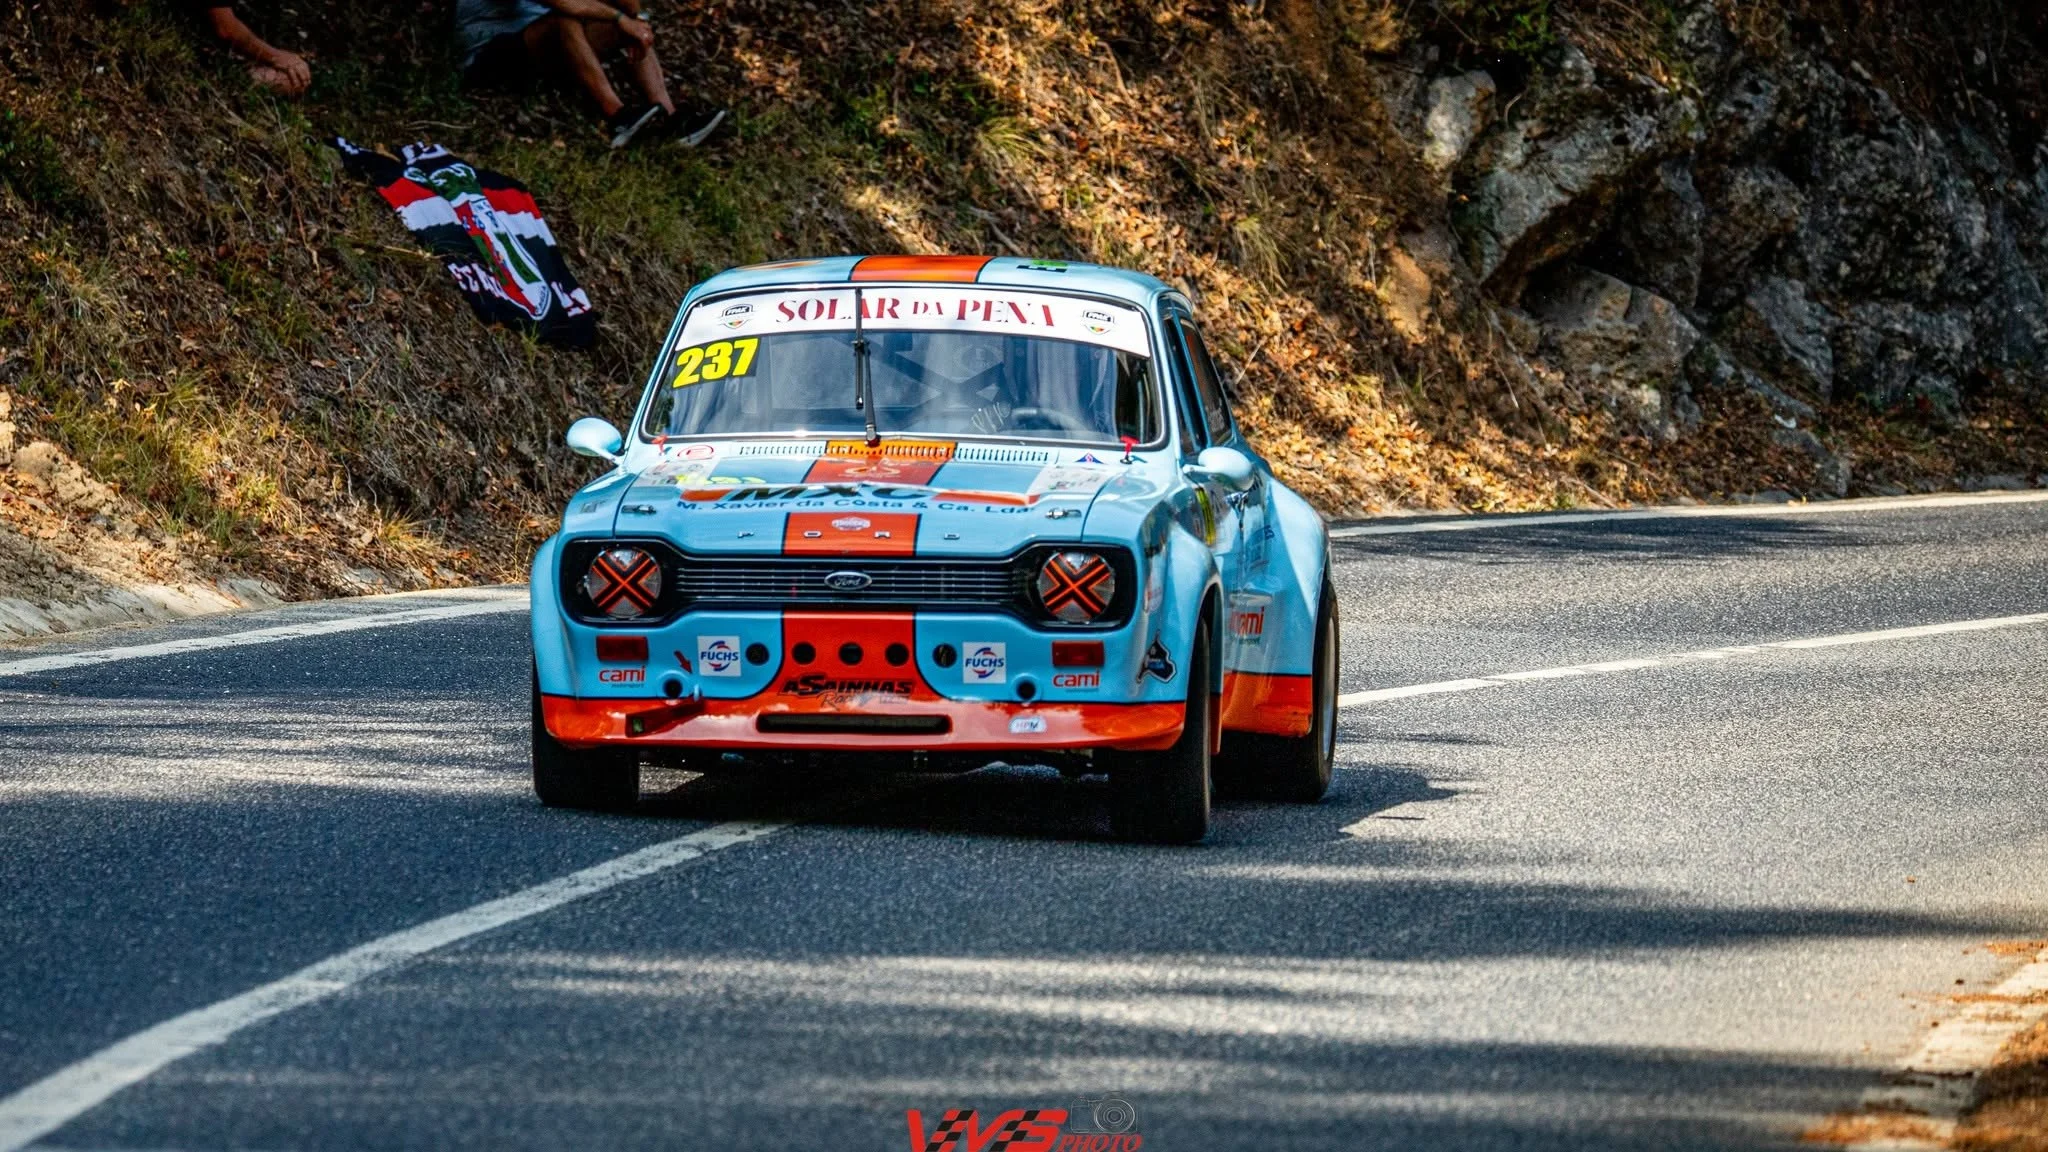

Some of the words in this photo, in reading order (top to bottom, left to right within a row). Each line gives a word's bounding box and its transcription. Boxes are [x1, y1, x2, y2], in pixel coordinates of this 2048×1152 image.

[776, 297, 900, 323] SOLAR
[912, 301, 945, 316] DA
[956, 299, 1055, 327] PENA
[672, 338, 758, 388] 237
[676, 501, 703, 511] M.
[713, 500, 789, 511] Xavier
[796, 499, 821, 508] da
[833, 499, 904, 509] Costa
[911, 501, 929, 510] &
[937, 502, 976, 513] Ca.
[700, 650, 739, 662] FUCHS
[965, 657, 1004, 668] FUCHS
[599, 665, 646, 682] cami
[1053, 669, 1100, 687] cami
